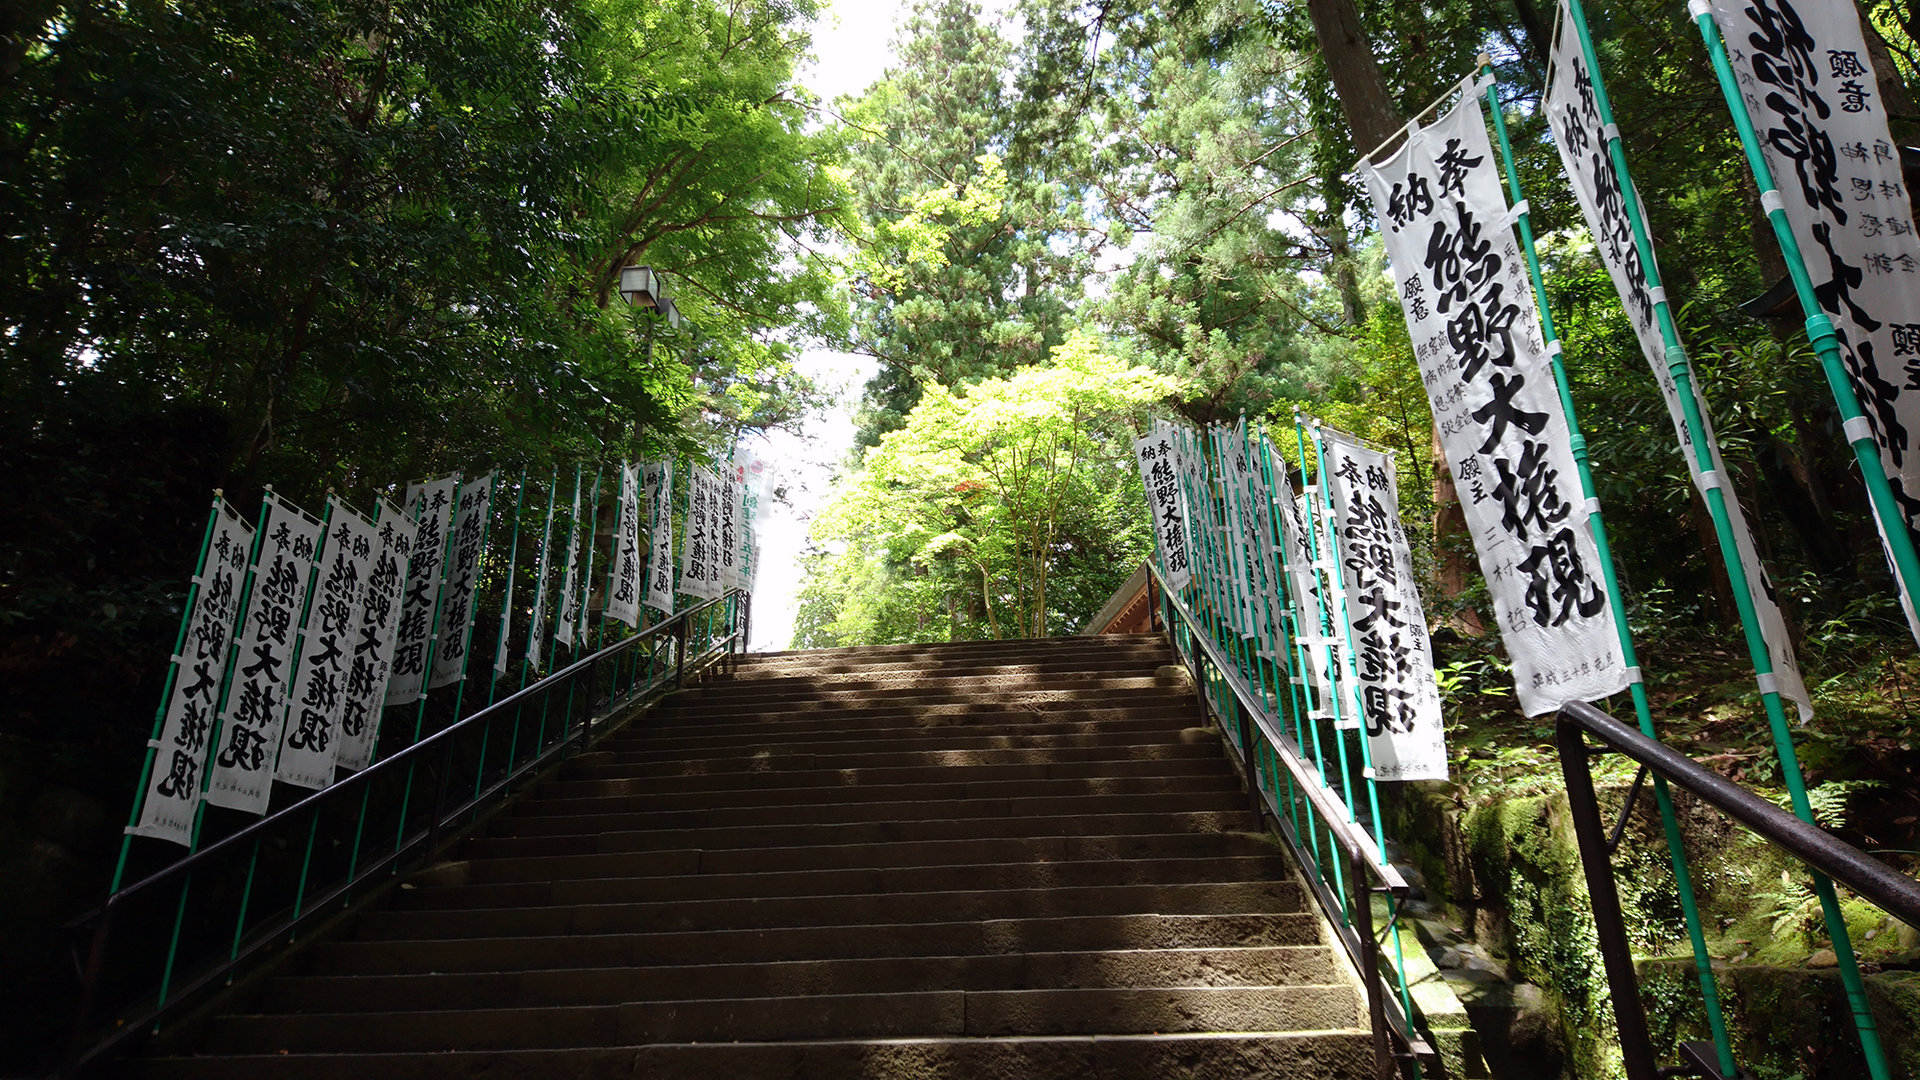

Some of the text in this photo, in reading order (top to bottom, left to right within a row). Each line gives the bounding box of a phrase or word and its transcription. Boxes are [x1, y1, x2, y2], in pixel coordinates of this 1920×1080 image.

[1386, 138, 1484, 233] 奉納
[1403, 273, 1429, 324] 願意
[1141, 440, 1172, 463] 奉納
[1424, 201, 1605, 628] 熊野大権現
[1151, 458, 1188, 573] 熊野大権現
[1458, 454, 1488, 505] 願主
[443, 514, 481, 661] 熊野大権現
